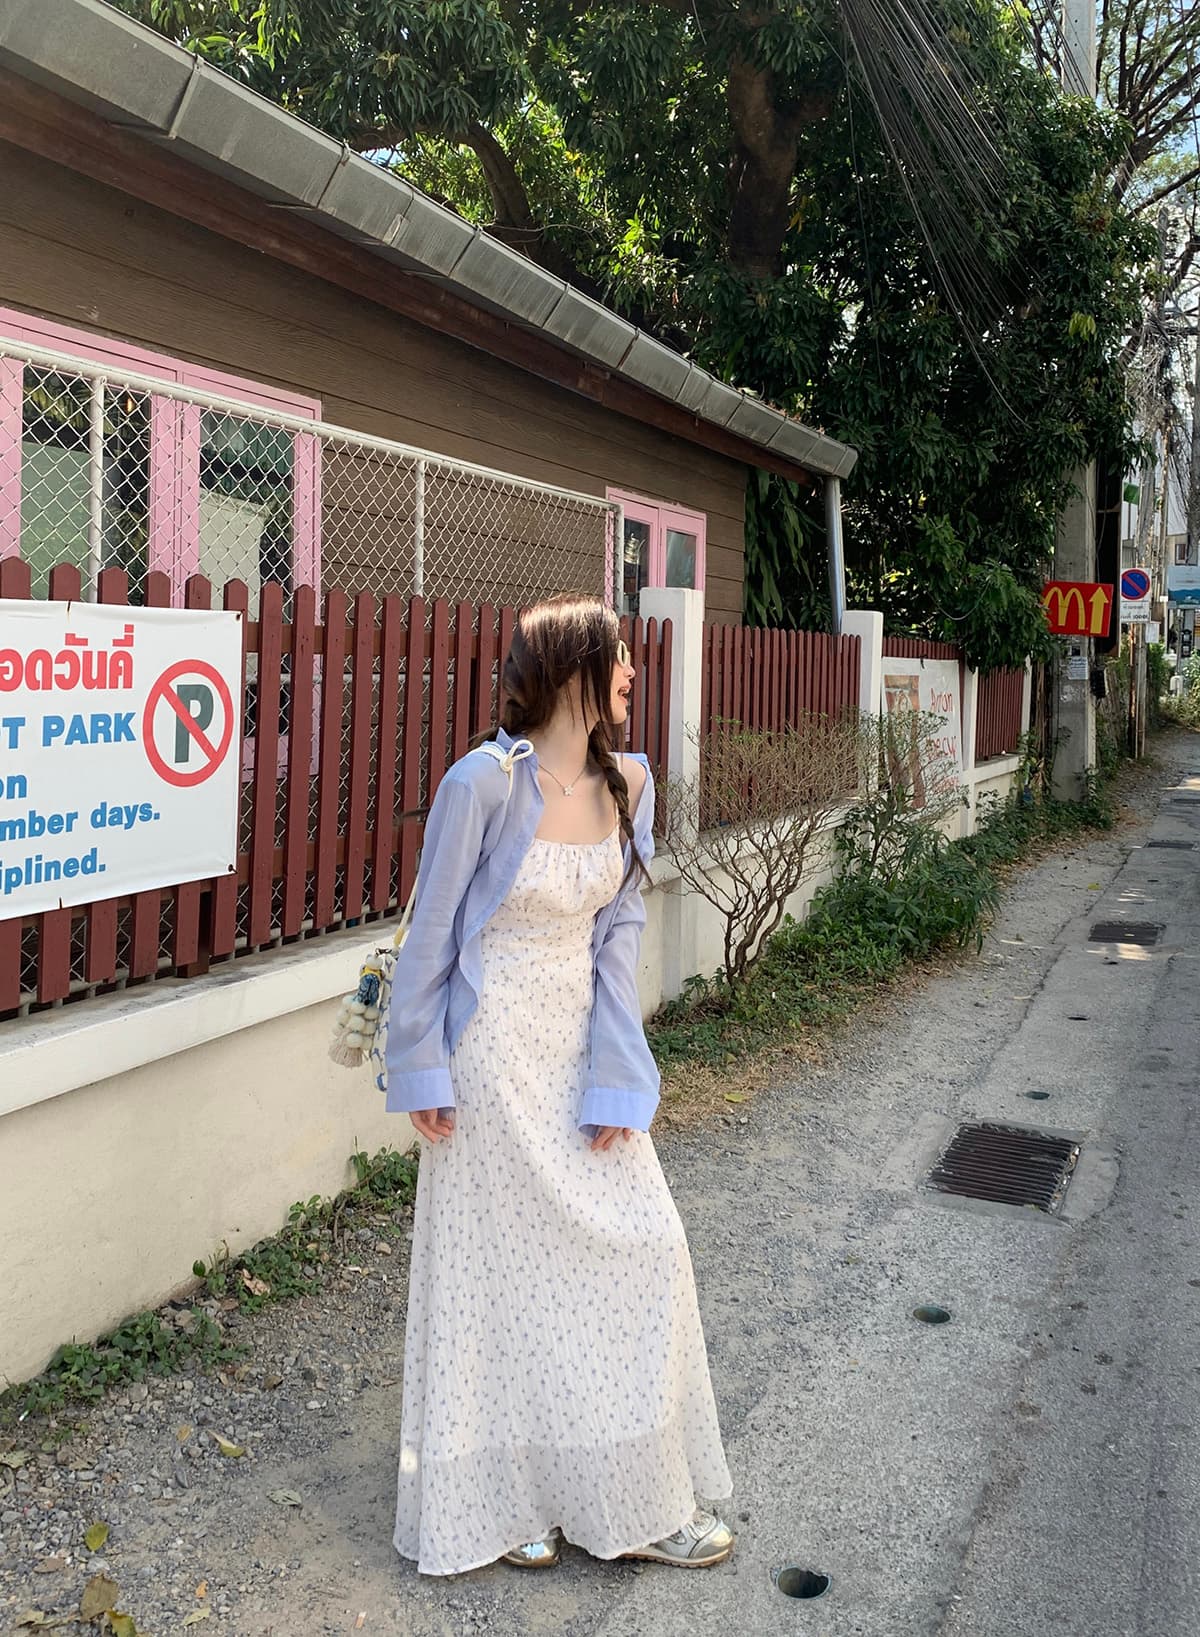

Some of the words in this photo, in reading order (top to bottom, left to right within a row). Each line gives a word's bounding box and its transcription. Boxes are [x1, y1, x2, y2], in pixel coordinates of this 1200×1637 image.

[0, 716, 26, 749] T
[42, 712, 136, 747] PARK
[0, 774, 27, 799] n
[90, 801, 161, 830] days.
